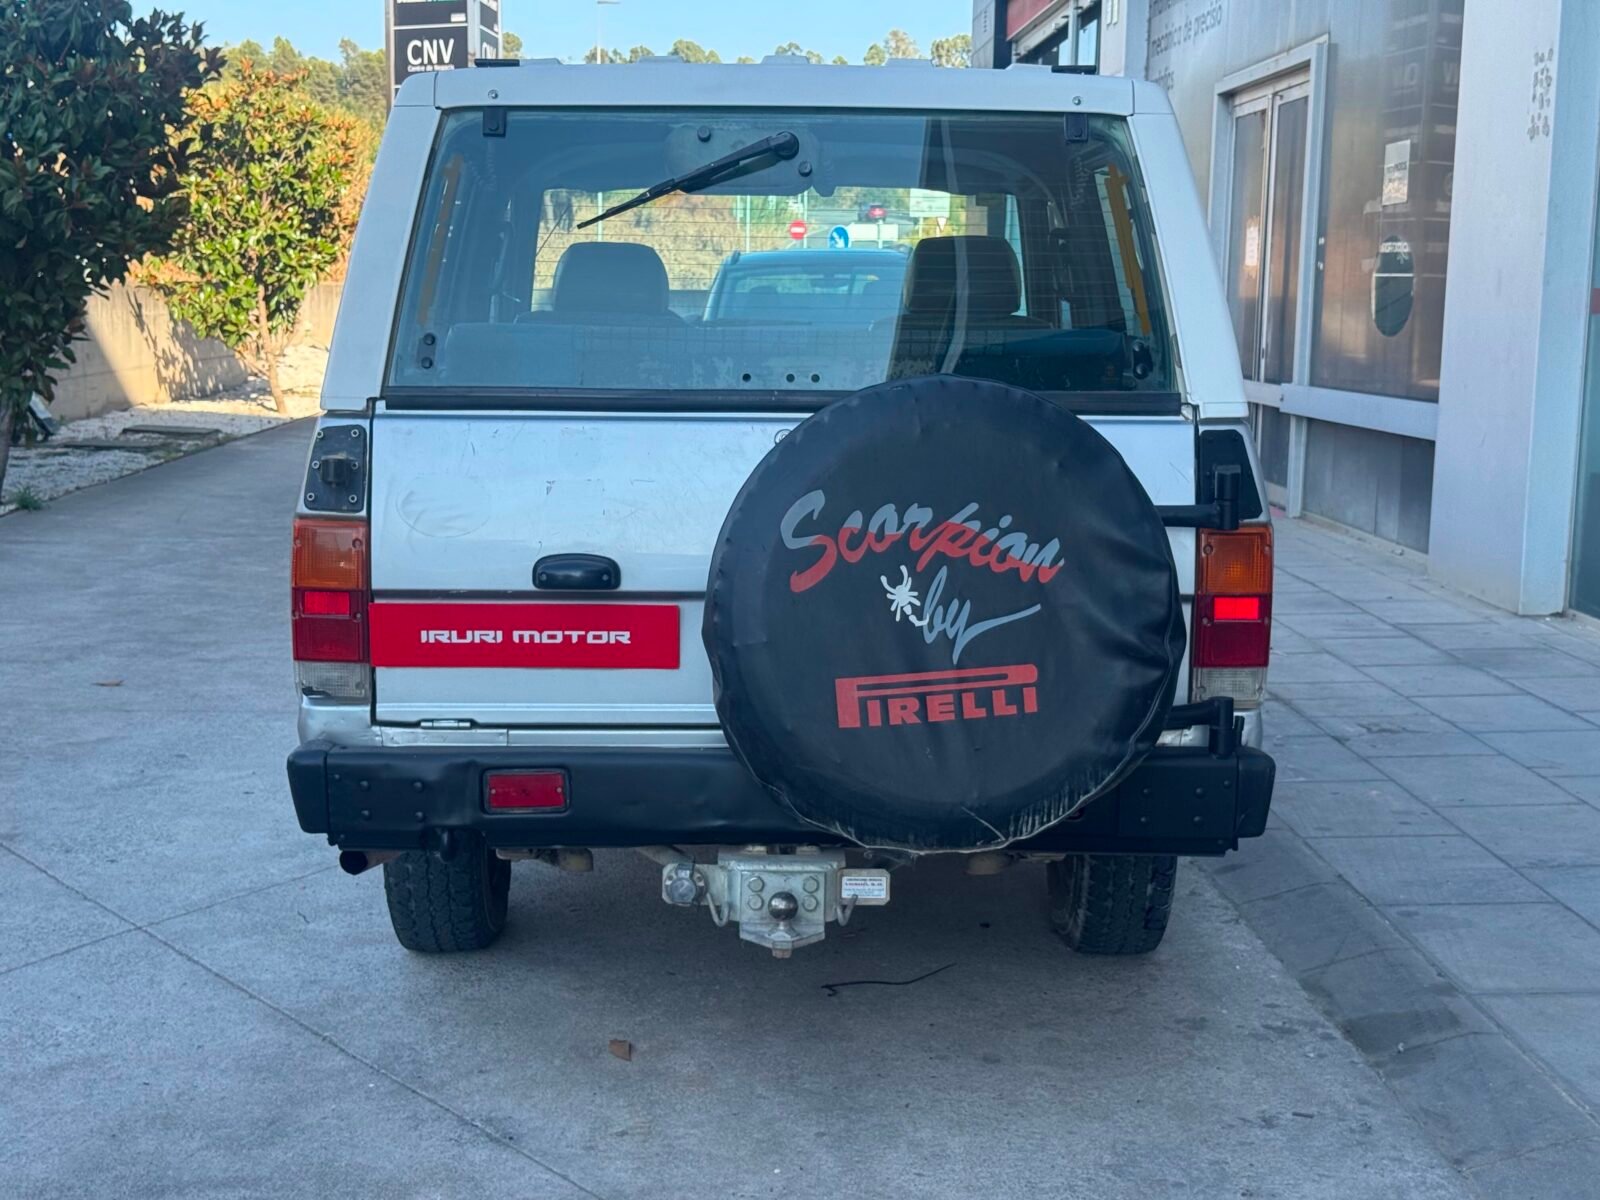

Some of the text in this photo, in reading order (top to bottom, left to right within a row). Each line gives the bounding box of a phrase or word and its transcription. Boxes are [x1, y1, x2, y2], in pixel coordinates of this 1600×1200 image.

[407, 38, 455, 65] CNV
[780, 489, 1065, 593] Scorpion
[420, 630, 631, 645] IRURI MOTOR
[922, 565, 1041, 664] by
[835, 664, 1038, 728] PIRELLI
